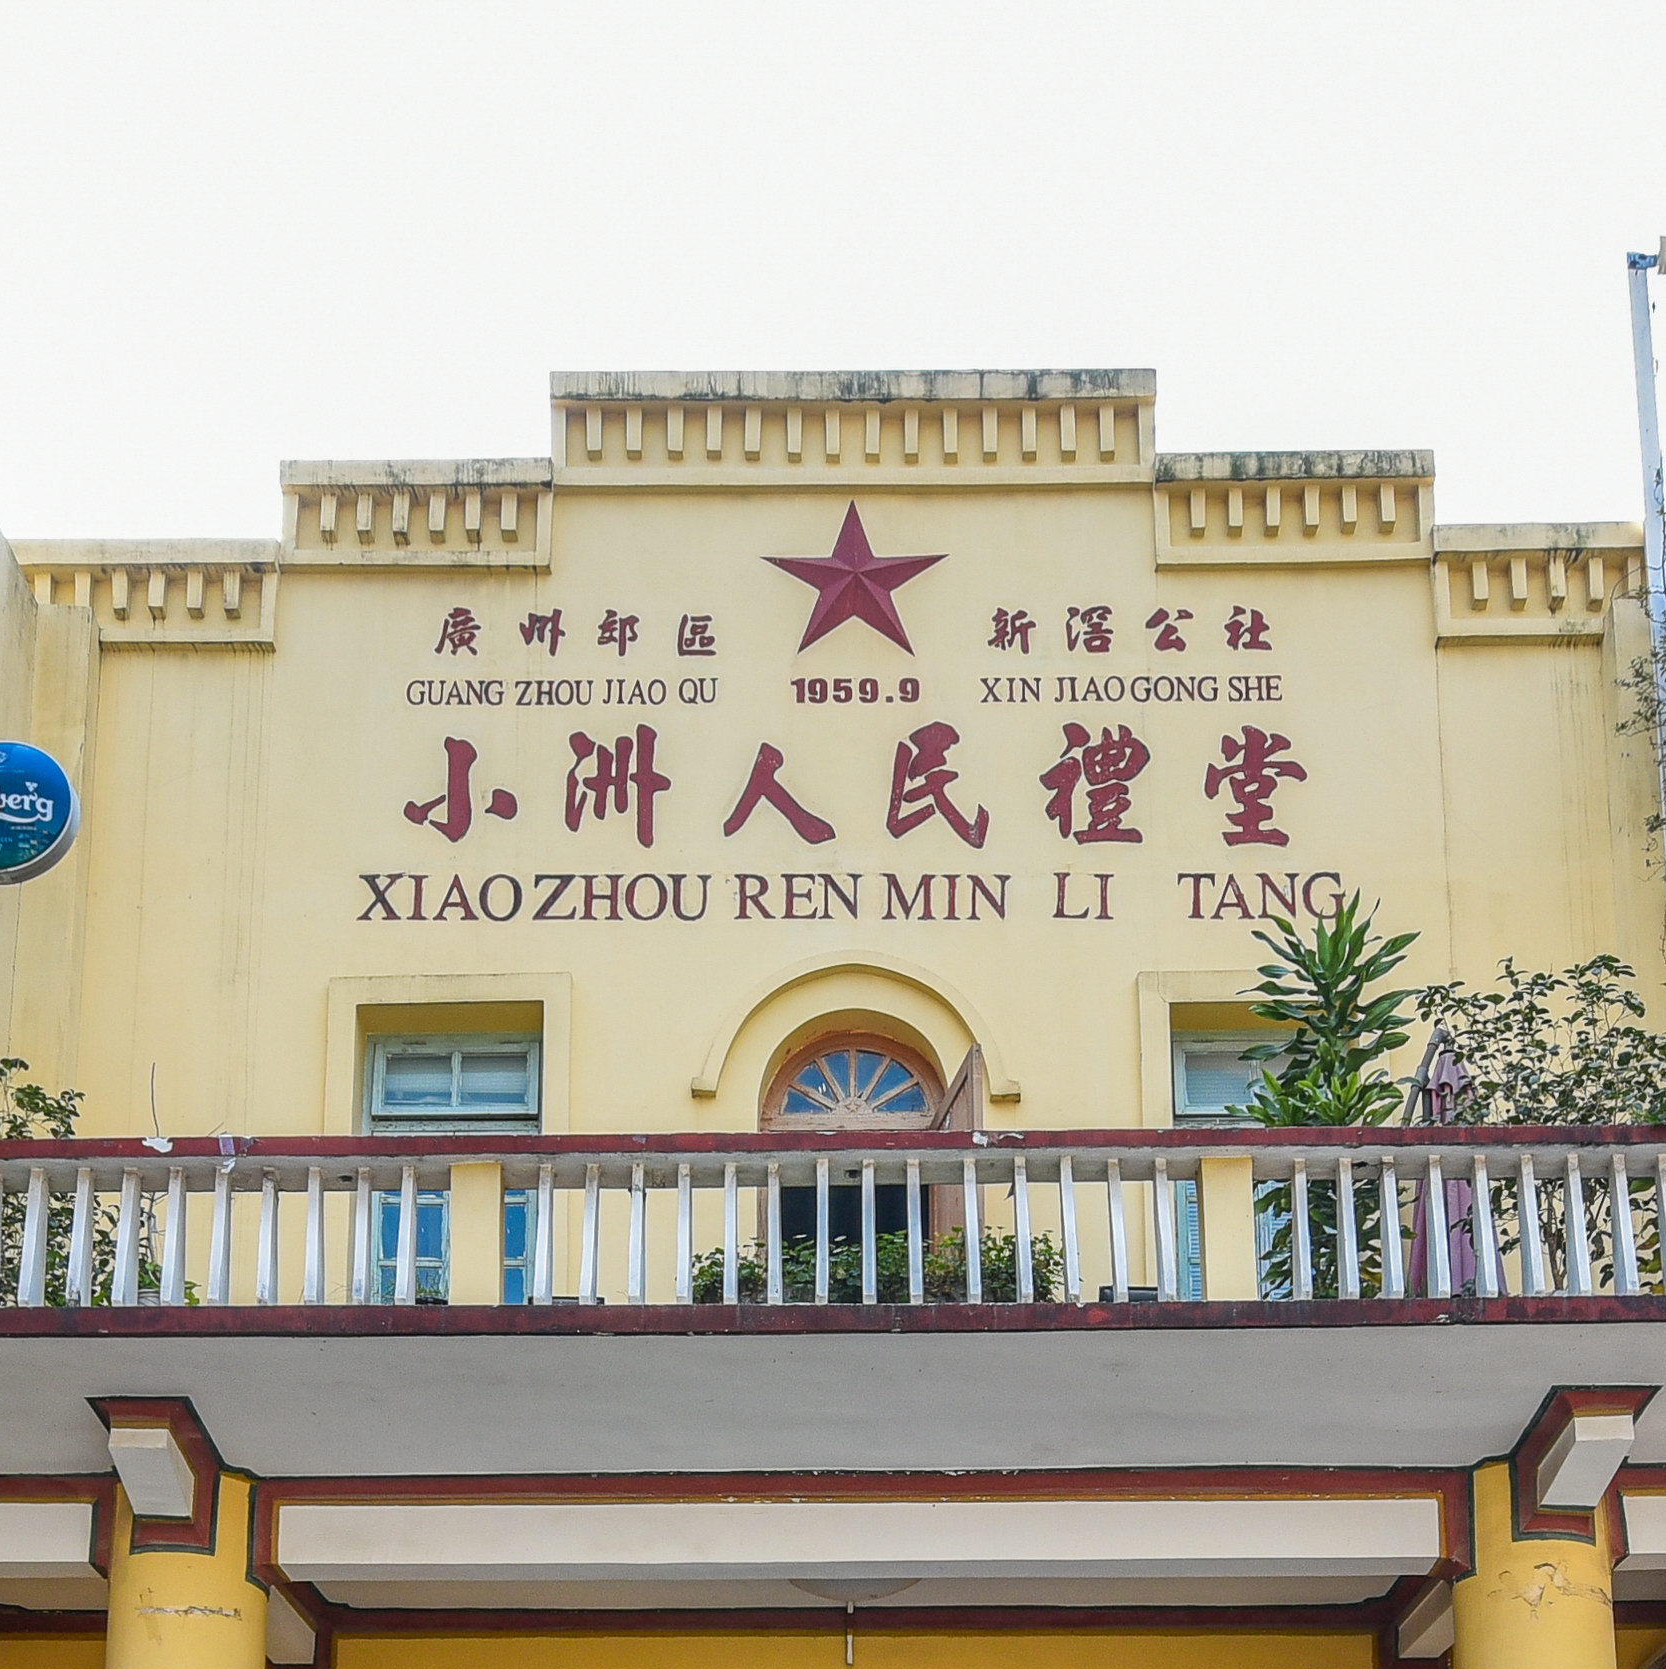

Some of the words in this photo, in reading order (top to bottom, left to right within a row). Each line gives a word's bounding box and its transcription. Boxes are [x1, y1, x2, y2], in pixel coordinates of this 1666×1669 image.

[434, 607, 718, 658] 廣州郊區
[987, 604, 1274, 655] 新滘公社
[406, 678, 505, 709] GUANG
[515, 678, 593, 709] ZHOU
[602, 677, 667, 709] JIAO
[678, 677, 719, 709] QU
[790, 676, 921, 705] 1959.9
[980, 676, 1042, 704] XIN
[1228, 676, 1283, 704] SHE
[404, 722, 1309, 850] 小洲人民禮堂
[733, 872, 860, 923] REN
[880, 872, 1012, 923] MIN
[1052, 872, 1114, 922] LI
[1177, 870, 1348, 923] TANG
